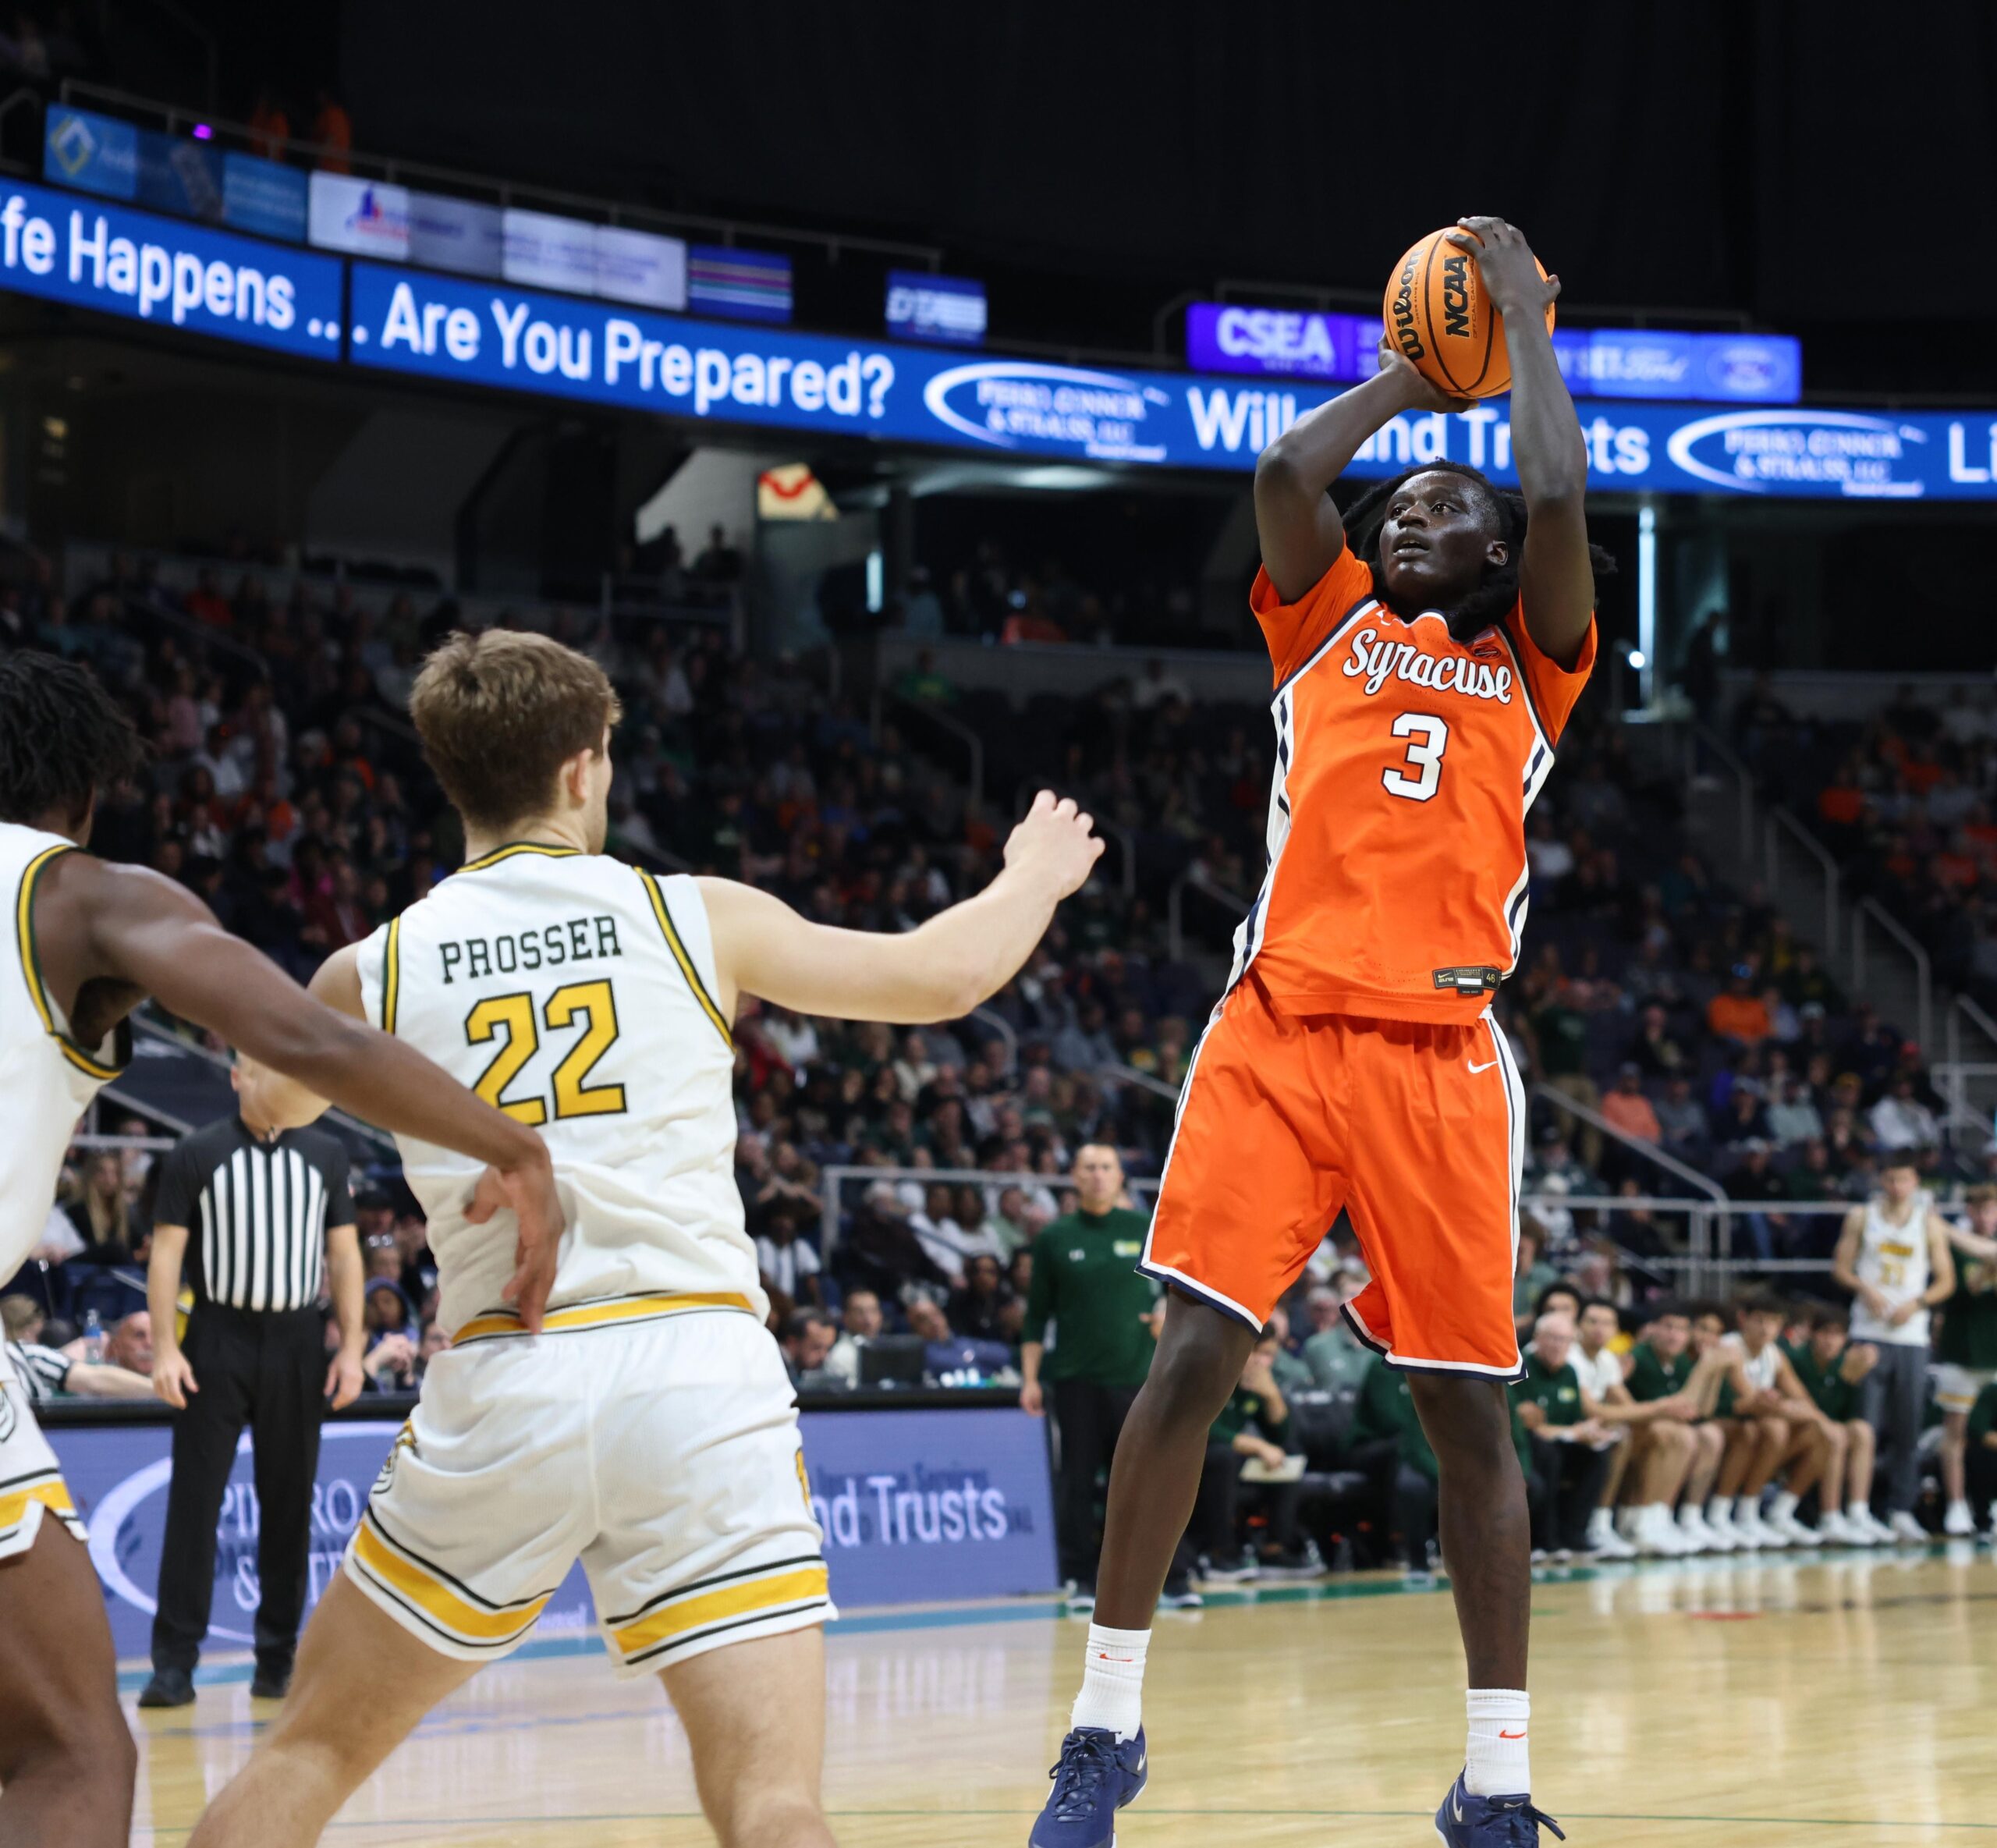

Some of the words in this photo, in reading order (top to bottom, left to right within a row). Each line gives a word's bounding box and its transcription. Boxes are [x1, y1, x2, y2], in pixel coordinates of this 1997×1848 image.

[0, 194, 55, 275] fe
[69, 210, 295, 330] Happens
[1392, 247, 1426, 361] Wilson
[1443, 254, 1471, 339] NCAA
[380, 282, 481, 360] Are
[491, 298, 592, 381] You
[605, 318, 896, 419] Prepared?
[1216, 307, 1337, 364] CSEA
[1186, 386, 1314, 454] Will
[1456, 407, 1651, 475] Trts
[1343, 628, 1513, 705] Syracuse
[1381, 711, 1449, 803] 3
[439, 915, 622, 984] PROSSER
[1486, 973, 1496, 984] 46
[464, 977, 627, 1128] 22
[811, 1477, 860, 1548] nd
[866, 1474, 1008, 1546] Trusts
